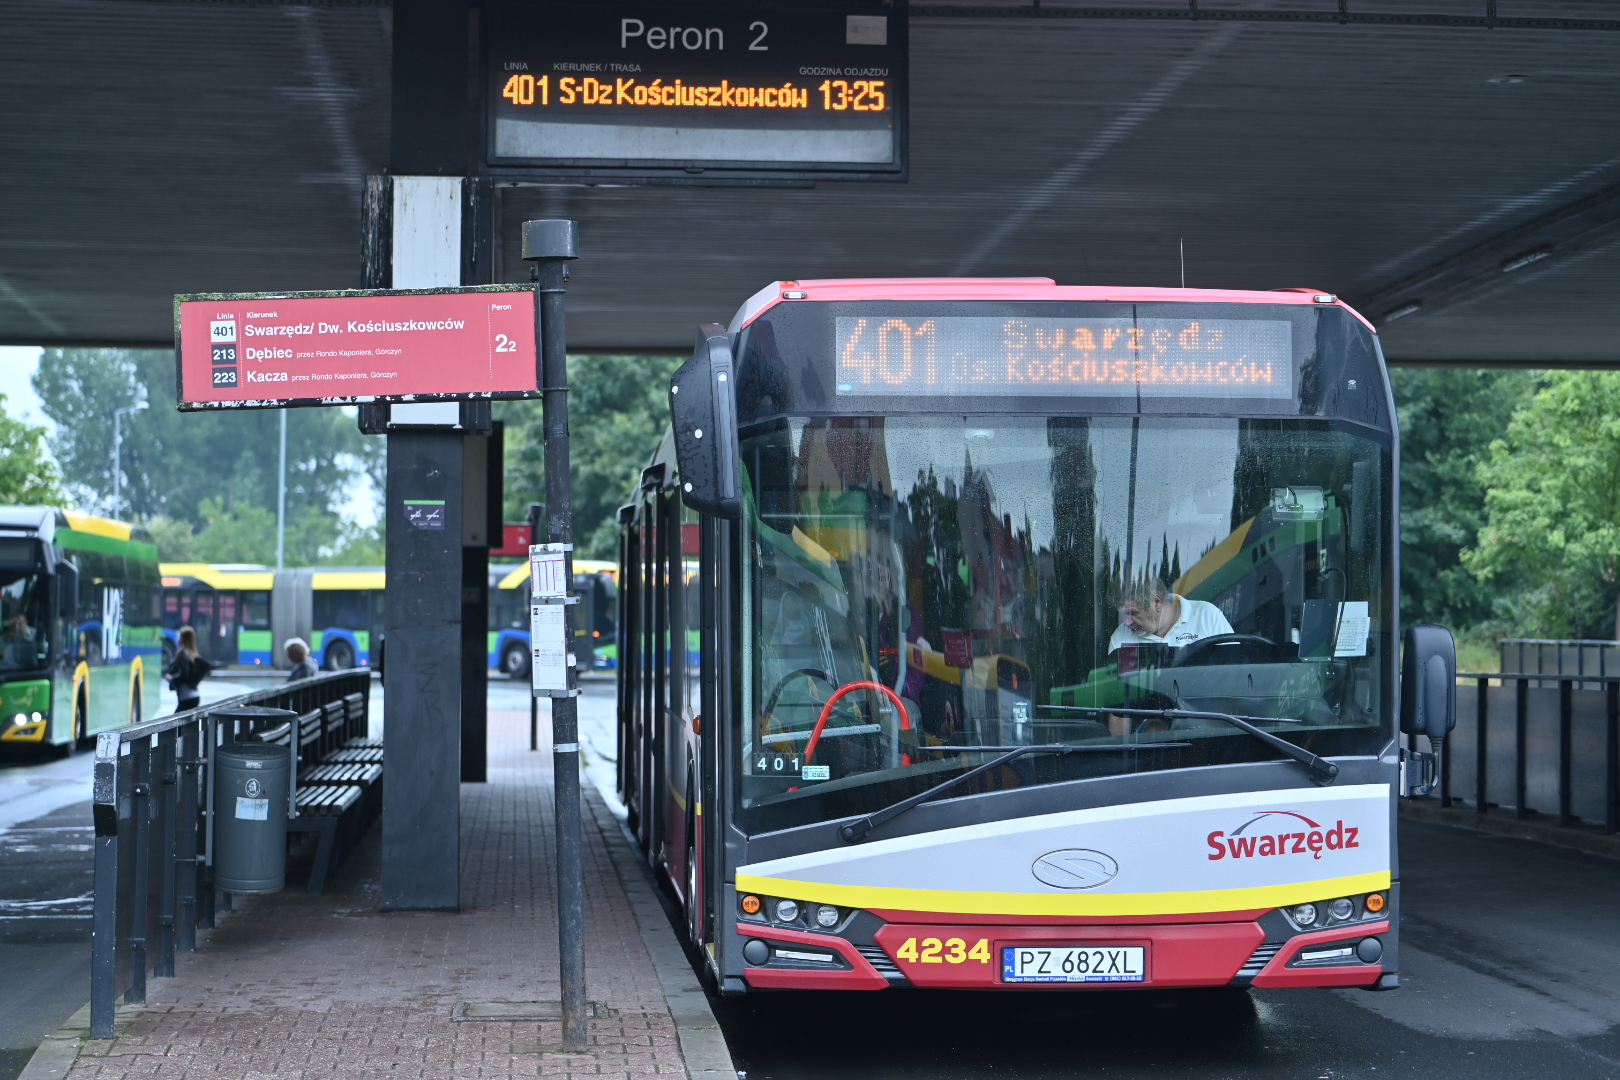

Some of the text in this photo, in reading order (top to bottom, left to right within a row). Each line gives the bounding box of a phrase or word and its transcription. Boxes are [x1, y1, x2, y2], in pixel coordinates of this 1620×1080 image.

[621, 18, 768, 51] Peron 2
[504, 62, 529, 71] LINIA
[553, 63, 602, 72] KIERUNEK
[609, 64, 642, 73] TRASA
[799, 67, 888, 77] GODZINA ODJAZDU
[502, 74, 548, 105] 401
[616, 78, 807, 108] Kościuszkowców
[818, 79, 885, 110] 13:25
[246, 311, 278, 319] Kierunek
[213, 326, 234, 337] 401
[318, 322, 343, 334] Dw.
[347, 318, 465, 333] Kościuszkowców
[1004, 320, 1223, 353] Swarzędz
[213, 349, 236, 360] 213
[246, 347, 293, 362] Dębiec
[296, 351, 315, 359] przez
[339, 349, 374, 358] Kaponiera,
[375, 348, 402, 356] Górczyn
[841, 319, 938, 384] 401
[214, 371, 398, 384] 223 Kacza przez Rondo Kaponiera, Górczyn
[1008, 353, 1273, 382] Kościuszkowców
[1207, 820, 1360, 860] Swarzędz
[896, 937, 991, 964] 4234
[1005, 965, 1014, 973] PL
[1020, 950, 1136, 974] PZ 682XL
